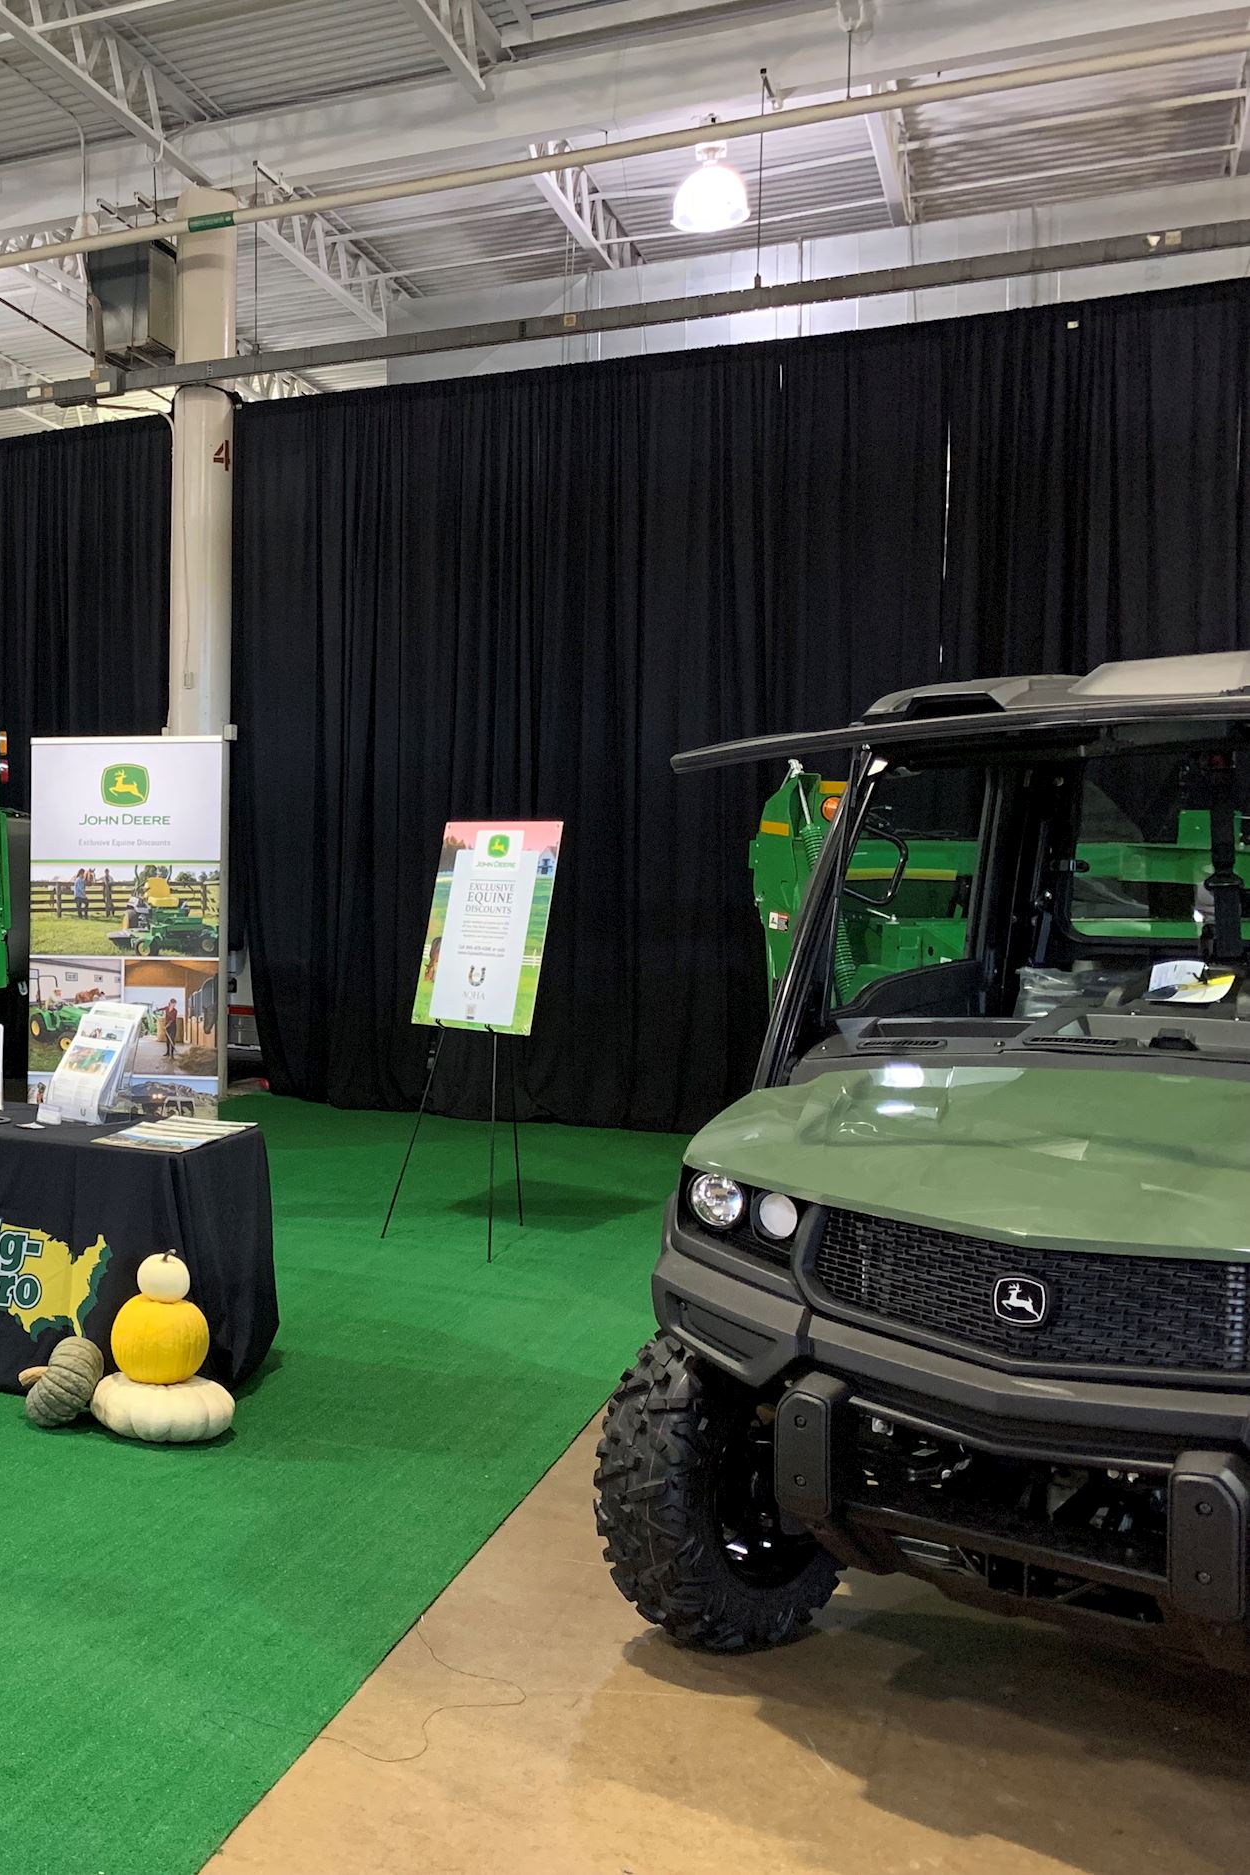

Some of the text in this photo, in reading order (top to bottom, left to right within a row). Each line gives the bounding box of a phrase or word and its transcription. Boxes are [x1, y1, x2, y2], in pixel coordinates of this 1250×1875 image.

[213, 440, 230, 471] 4
[78, 814, 171, 825] JOHN DEERE
[78, 838, 171, 848] Exclusive Equine Discounts
[469, 882, 515, 892] EXCLUSIVE
[467, 891, 514, 905] EQUINE
[465, 904, 513, 914] DISCOUNTS
